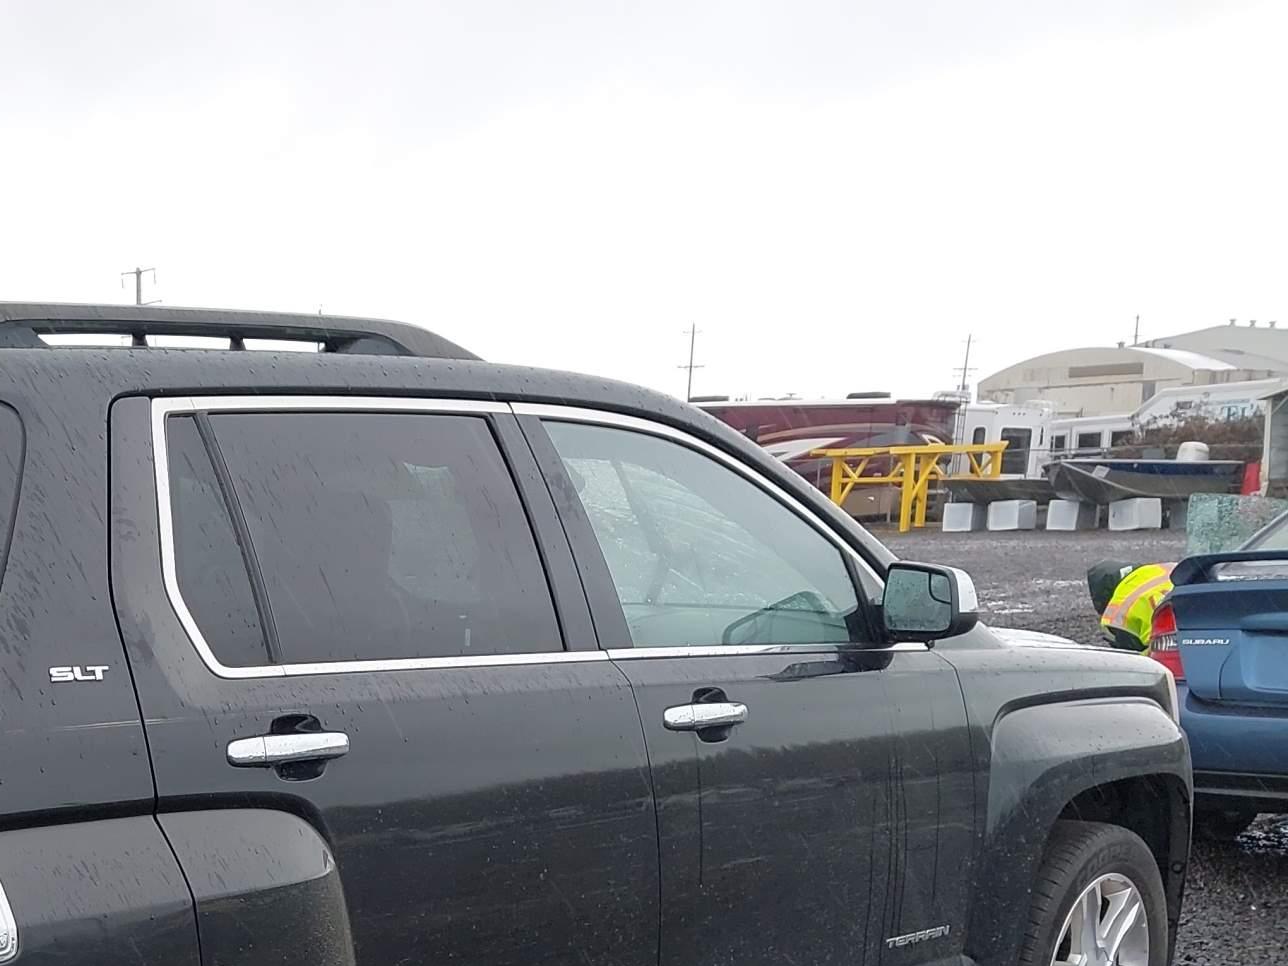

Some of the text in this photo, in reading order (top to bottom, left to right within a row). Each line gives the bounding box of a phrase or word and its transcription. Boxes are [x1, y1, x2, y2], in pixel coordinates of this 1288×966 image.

[1181, 638, 1231, 646] SUBARU
[49, 665, 110, 682] SLT
[885, 924, 951, 949] TERRAIN
